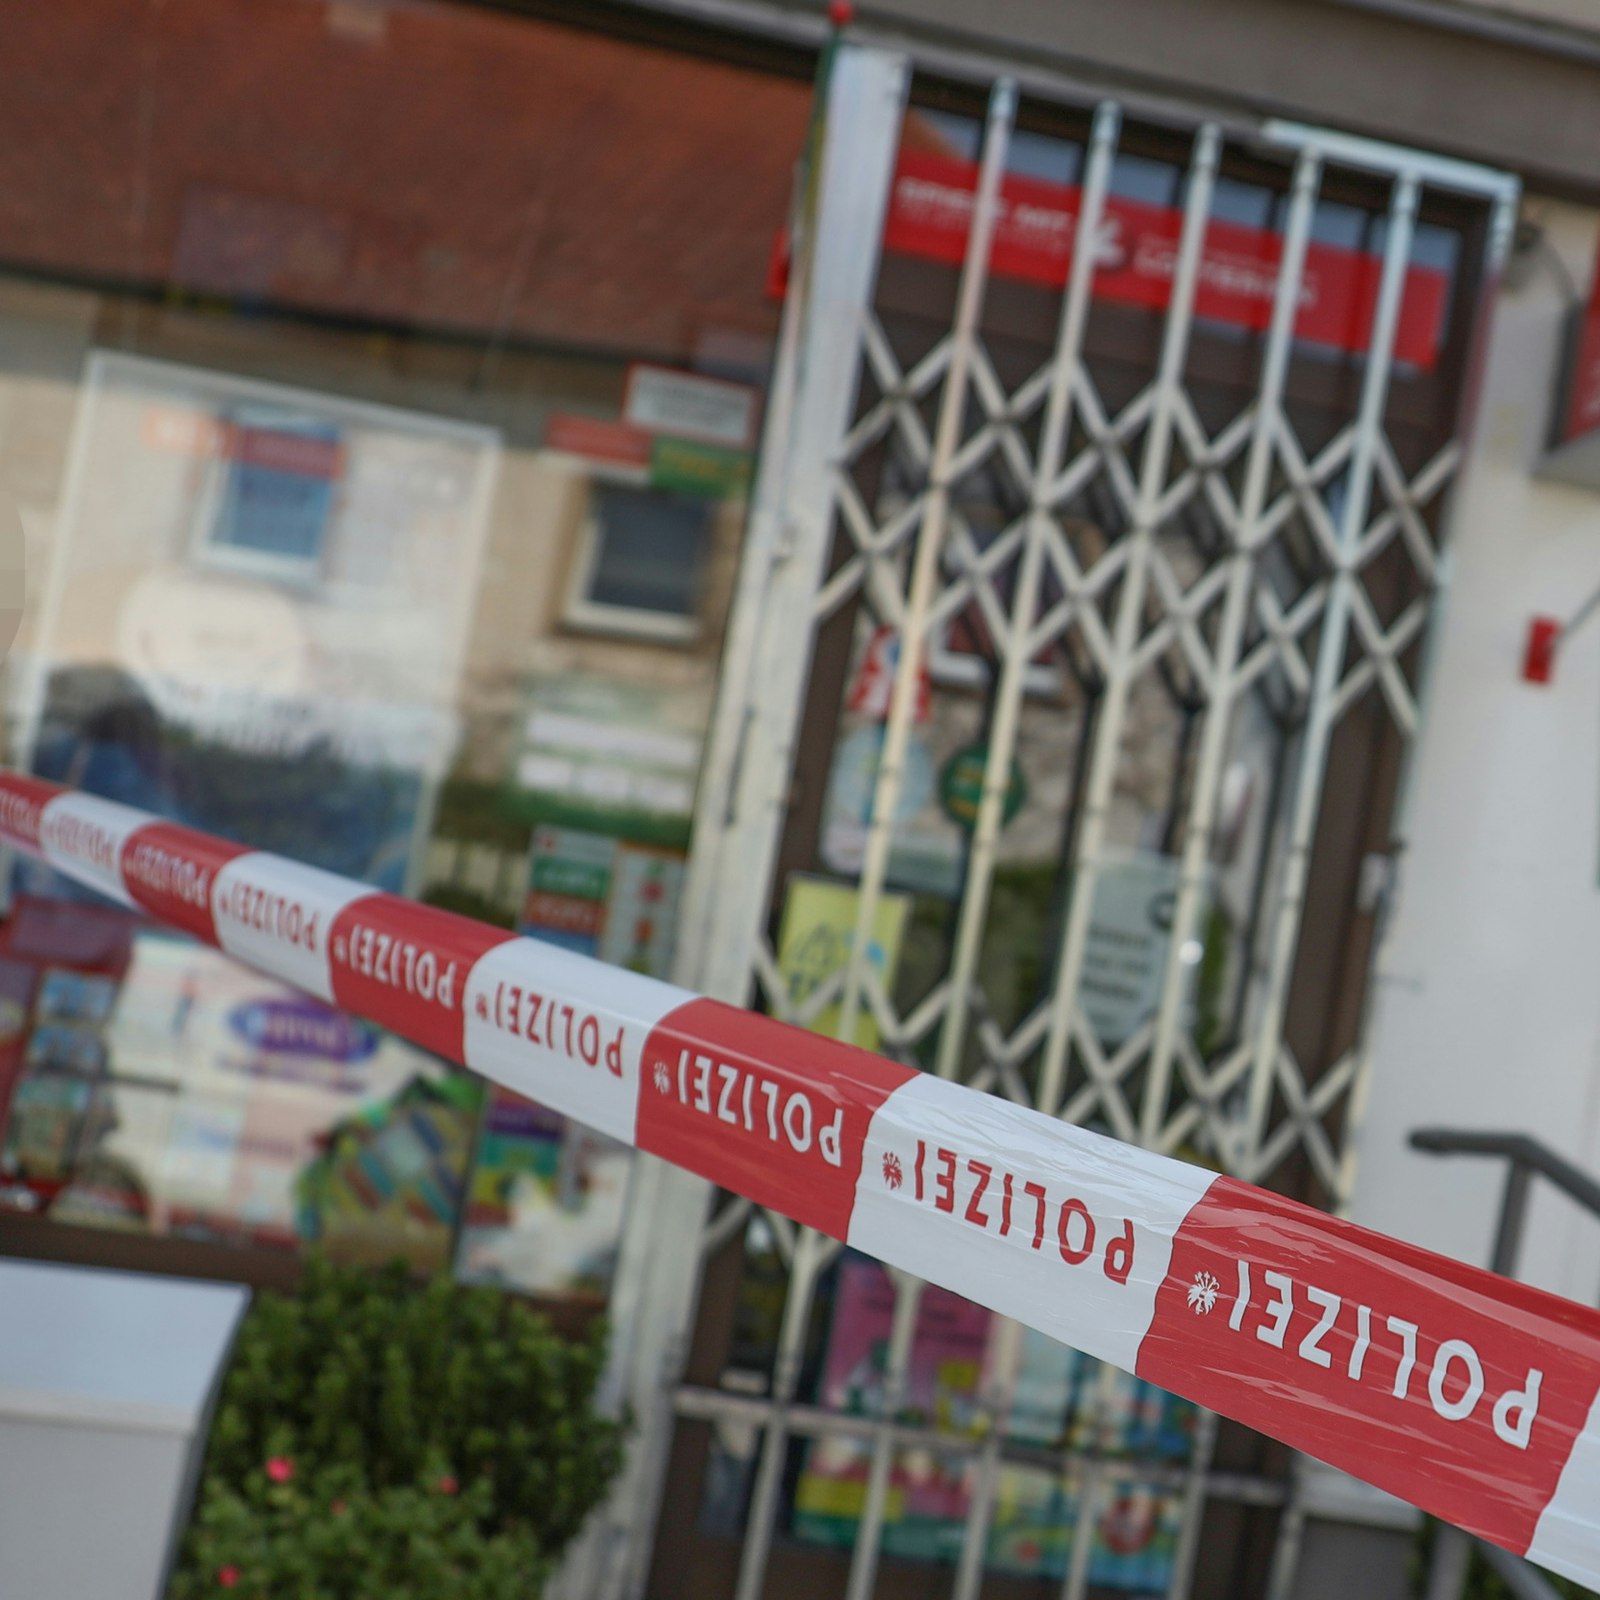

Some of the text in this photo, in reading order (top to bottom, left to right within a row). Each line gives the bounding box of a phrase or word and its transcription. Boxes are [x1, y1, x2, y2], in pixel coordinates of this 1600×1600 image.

[232, 881, 319, 953] POLIZEI
[349, 923, 455, 1009] POLIZEI
[494, 982, 625, 1078] POLIZEI
[677, 1049, 844, 1167] POLIZEI
[915, 1139, 1135, 1286] POLIZEI
[1228, 1259, 1543, 1450] POLIZEI
